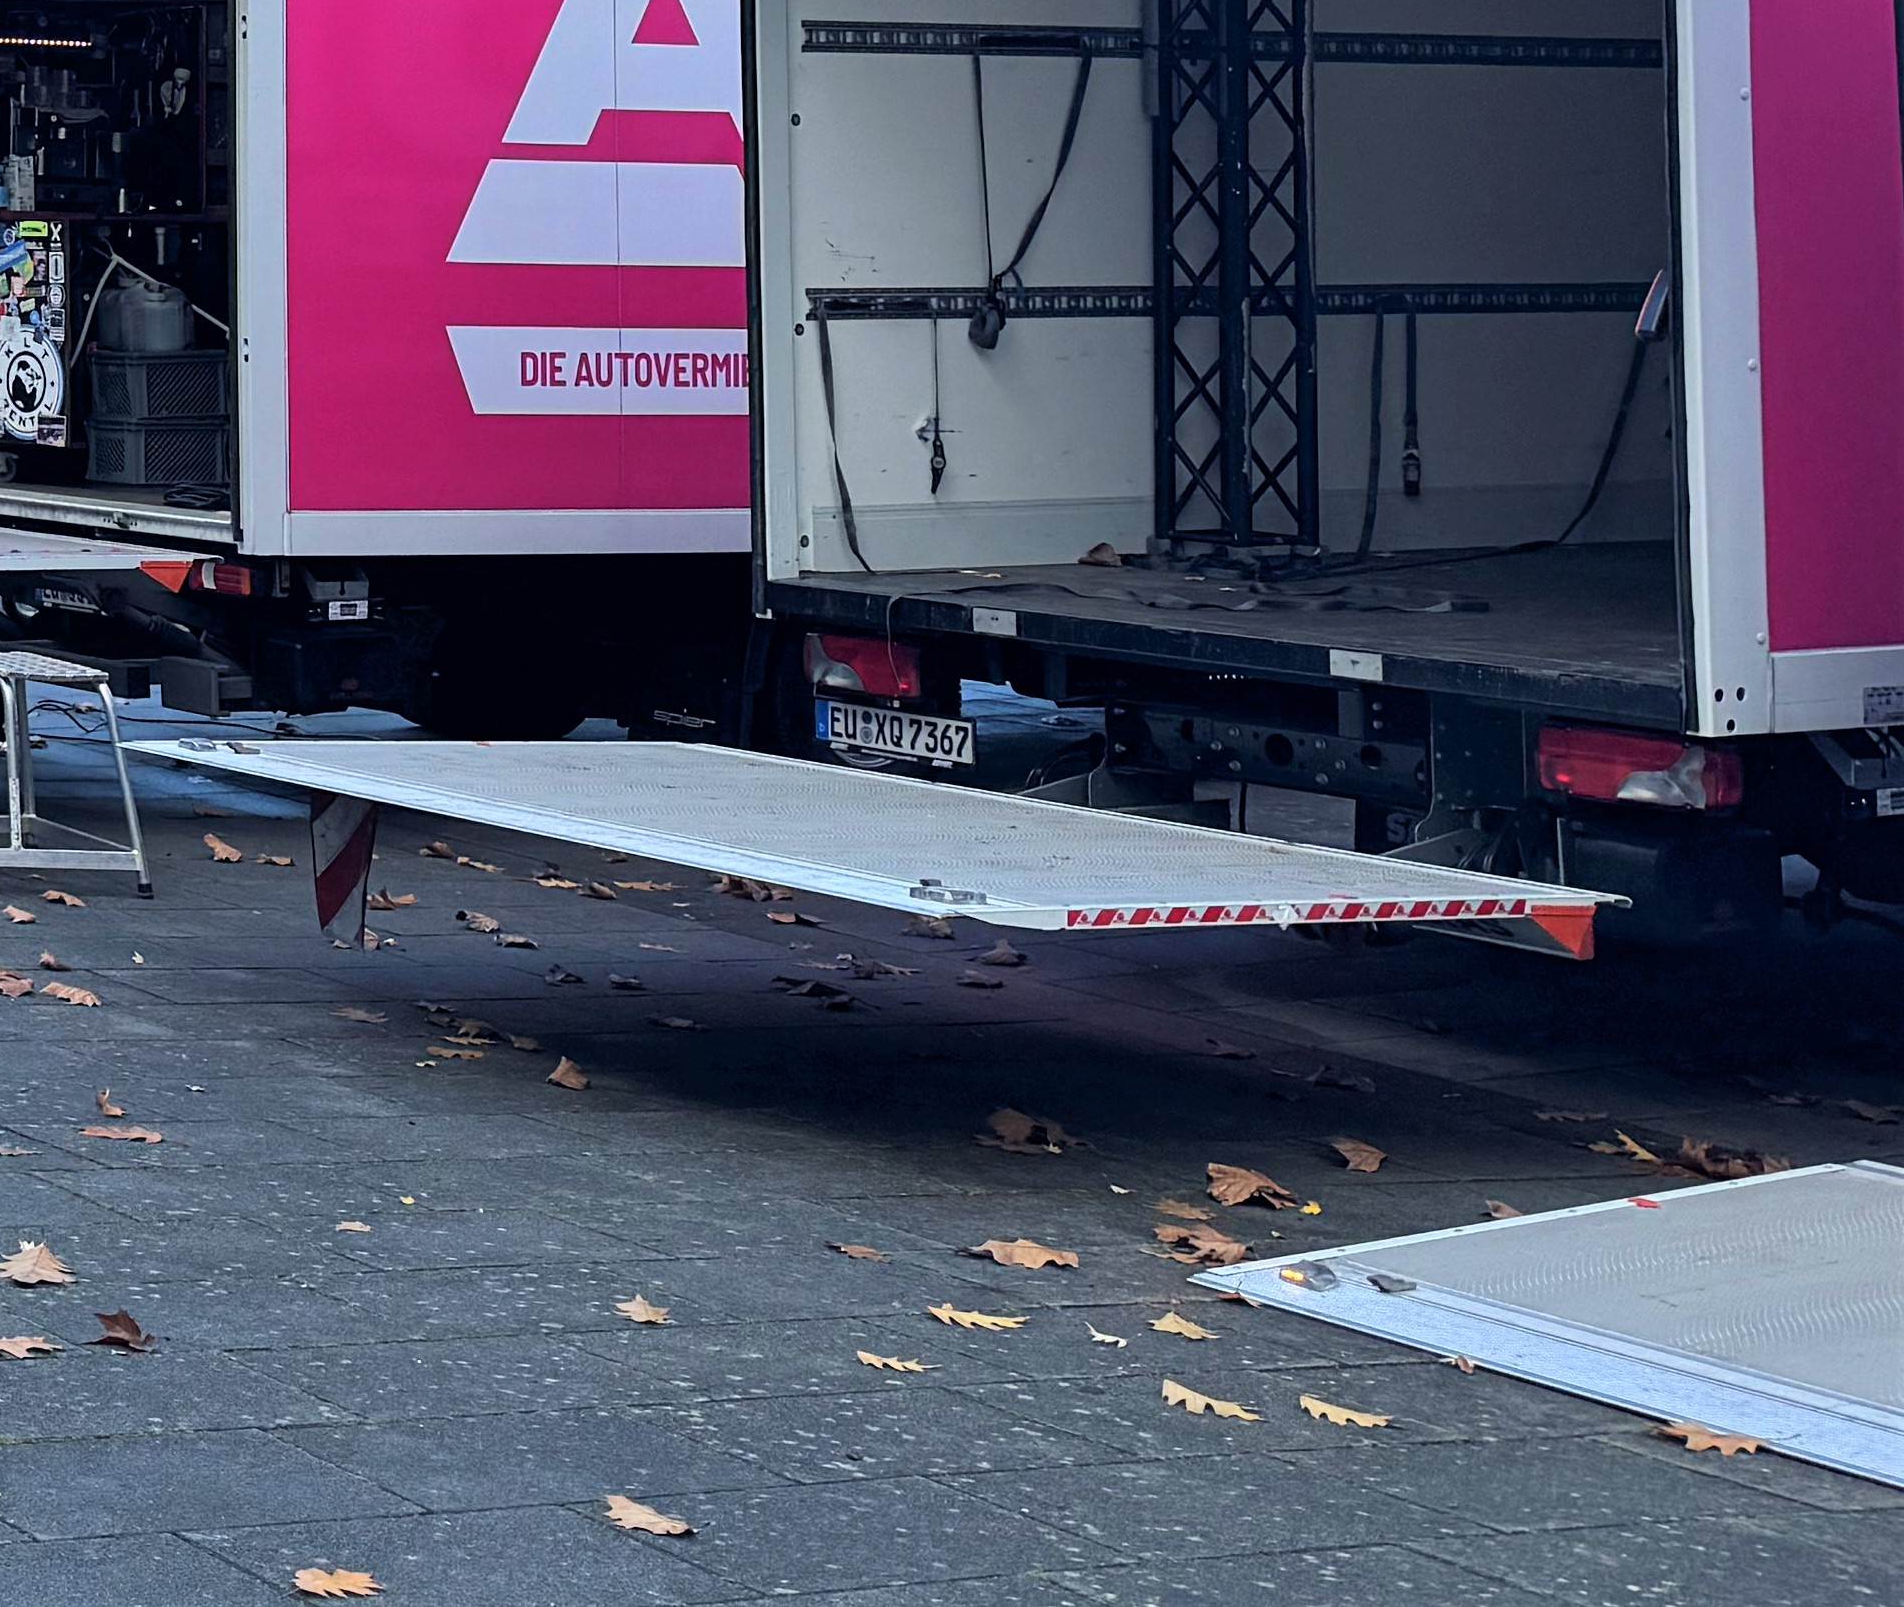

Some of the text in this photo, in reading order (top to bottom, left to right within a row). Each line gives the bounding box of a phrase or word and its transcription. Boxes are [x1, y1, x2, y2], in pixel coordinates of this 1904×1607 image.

[520, 352, 567, 387] DIE
[3, 398, 53, 428] ENTL
[830, 706, 969, 758] EU XQ 7367
